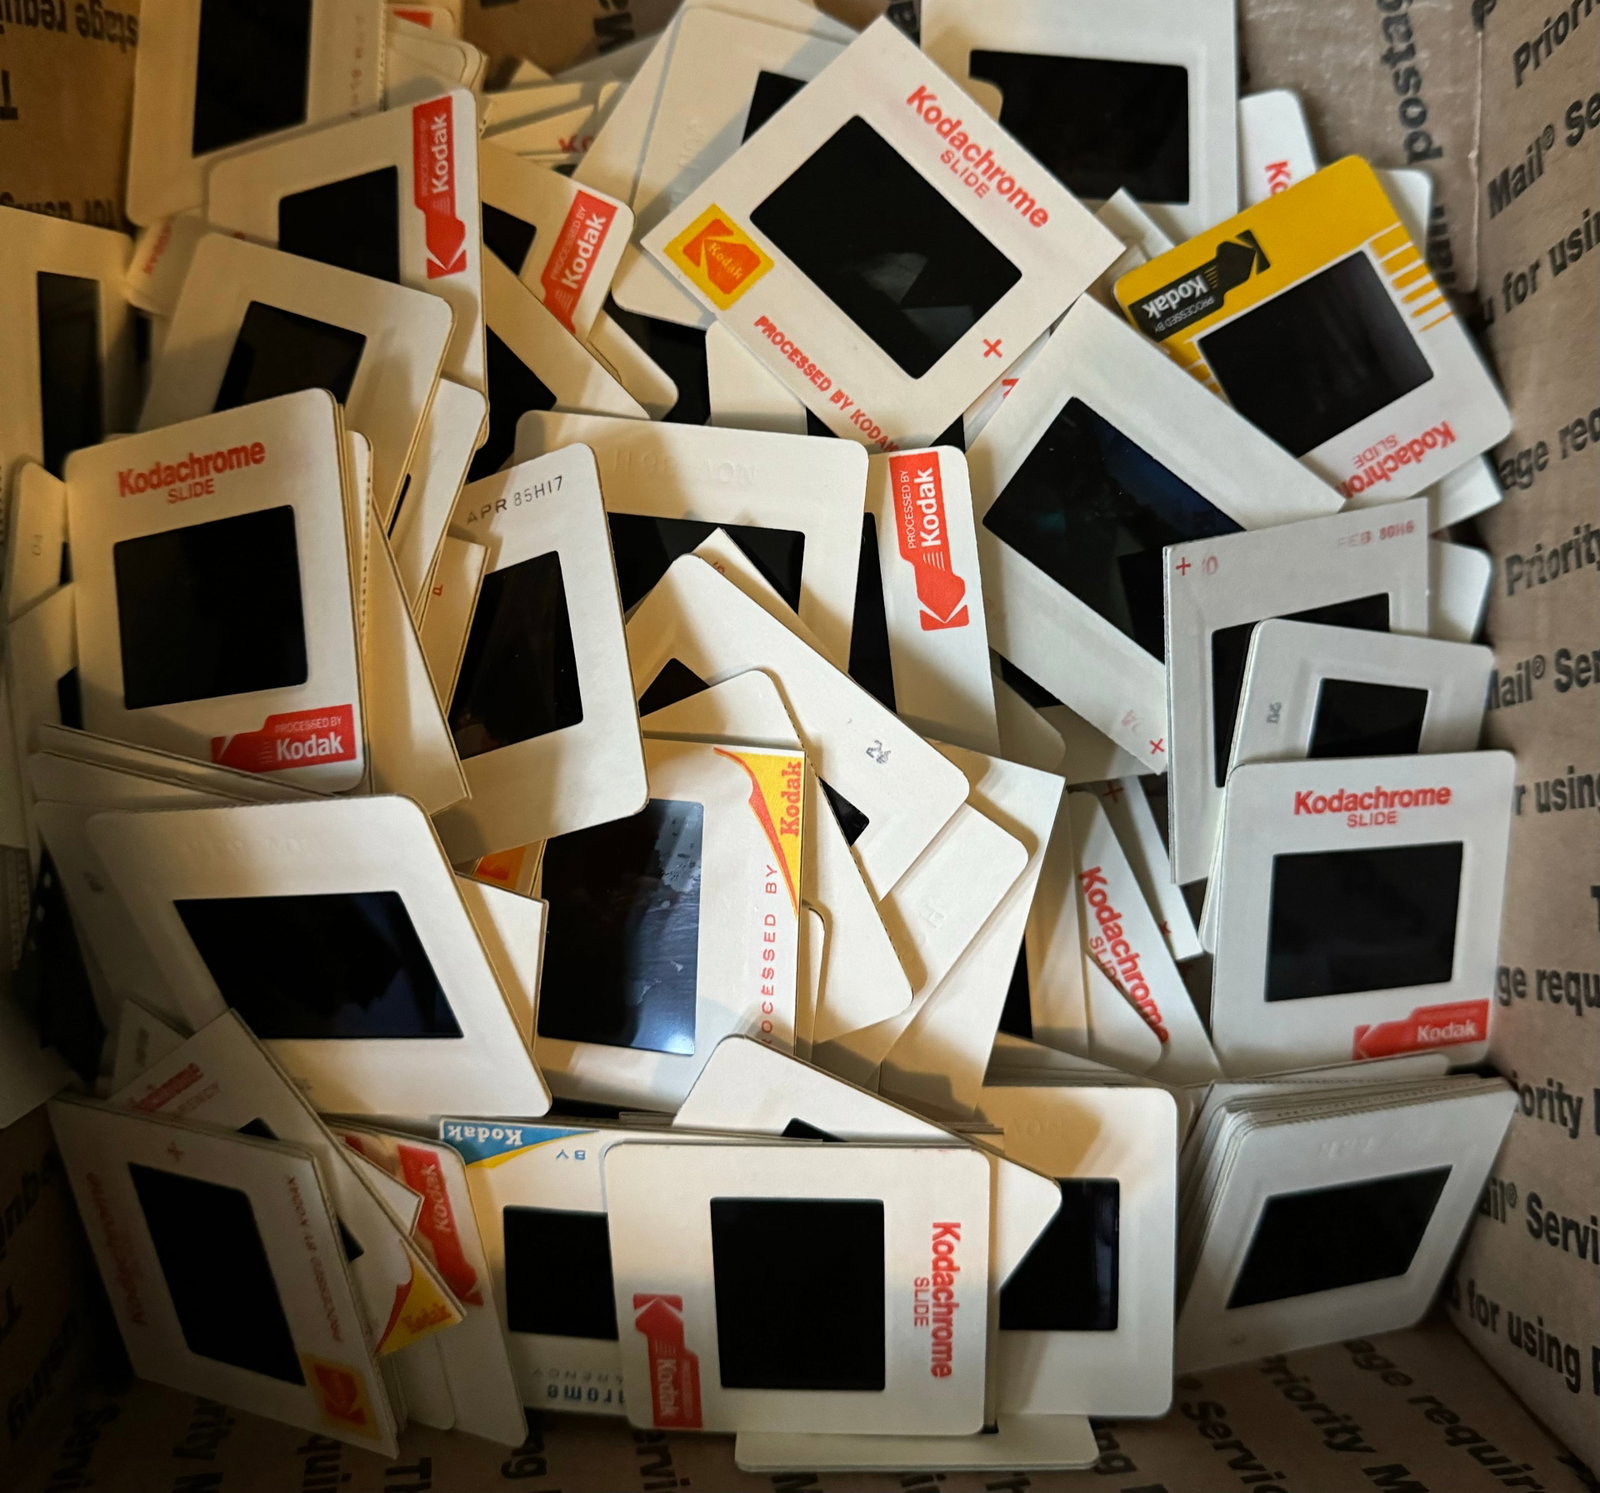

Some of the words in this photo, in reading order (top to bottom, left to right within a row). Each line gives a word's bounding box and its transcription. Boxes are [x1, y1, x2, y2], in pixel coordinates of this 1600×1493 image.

[430, 112, 448, 194] Kodak
[905, 85, 1050, 229] Kodachrome
[939, 148, 991, 200] SLIDE
[550, 225, 580, 282] PROCESSED
[560, 213, 607, 291] Kodak
[707, 240, 745, 282] Kodak
[1142, 274, 1210, 319] Kodak
[1502, 258, 1541, 314] for
[1165, 296, 1215, 329] PROCESSED
[752, 314, 832, 394] PROCESSED
[828, 388, 855, 412] BY
[117, 440, 267, 498] Kodachrome
[1352, 433, 1399, 469] SLIDE
[166, 478, 216, 504] SLIDE
[899, 469, 910, 484] BY
[466, 497, 509, 524] APR
[901, 483, 917, 550] PROCESSED
[914, 466, 942, 547] Kodak
[274, 718, 330, 734] PROCESSED
[329, 715, 343, 729] BY
[275, 733, 345, 762] Kodak
[779, 760, 802, 837] Kodak
[1293, 785, 1453, 817] Kodachrome
[1346, 809, 1399, 829] SLIDE
[764, 864, 778, 895] BY
[1416, 1019, 1477, 1042] Kodak
[446, 1123, 524, 1146] Kodak
[555, 1148, 587, 1162] BY
[913, 1276, 931, 1328] SLIDE
[930, 1221, 962, 1379] Kodachrome
[1467, 1277, 1501, 1334] for
[1507, 1315, 1581, 1395] using
[656, 1358, 678, 1418] Kodak
